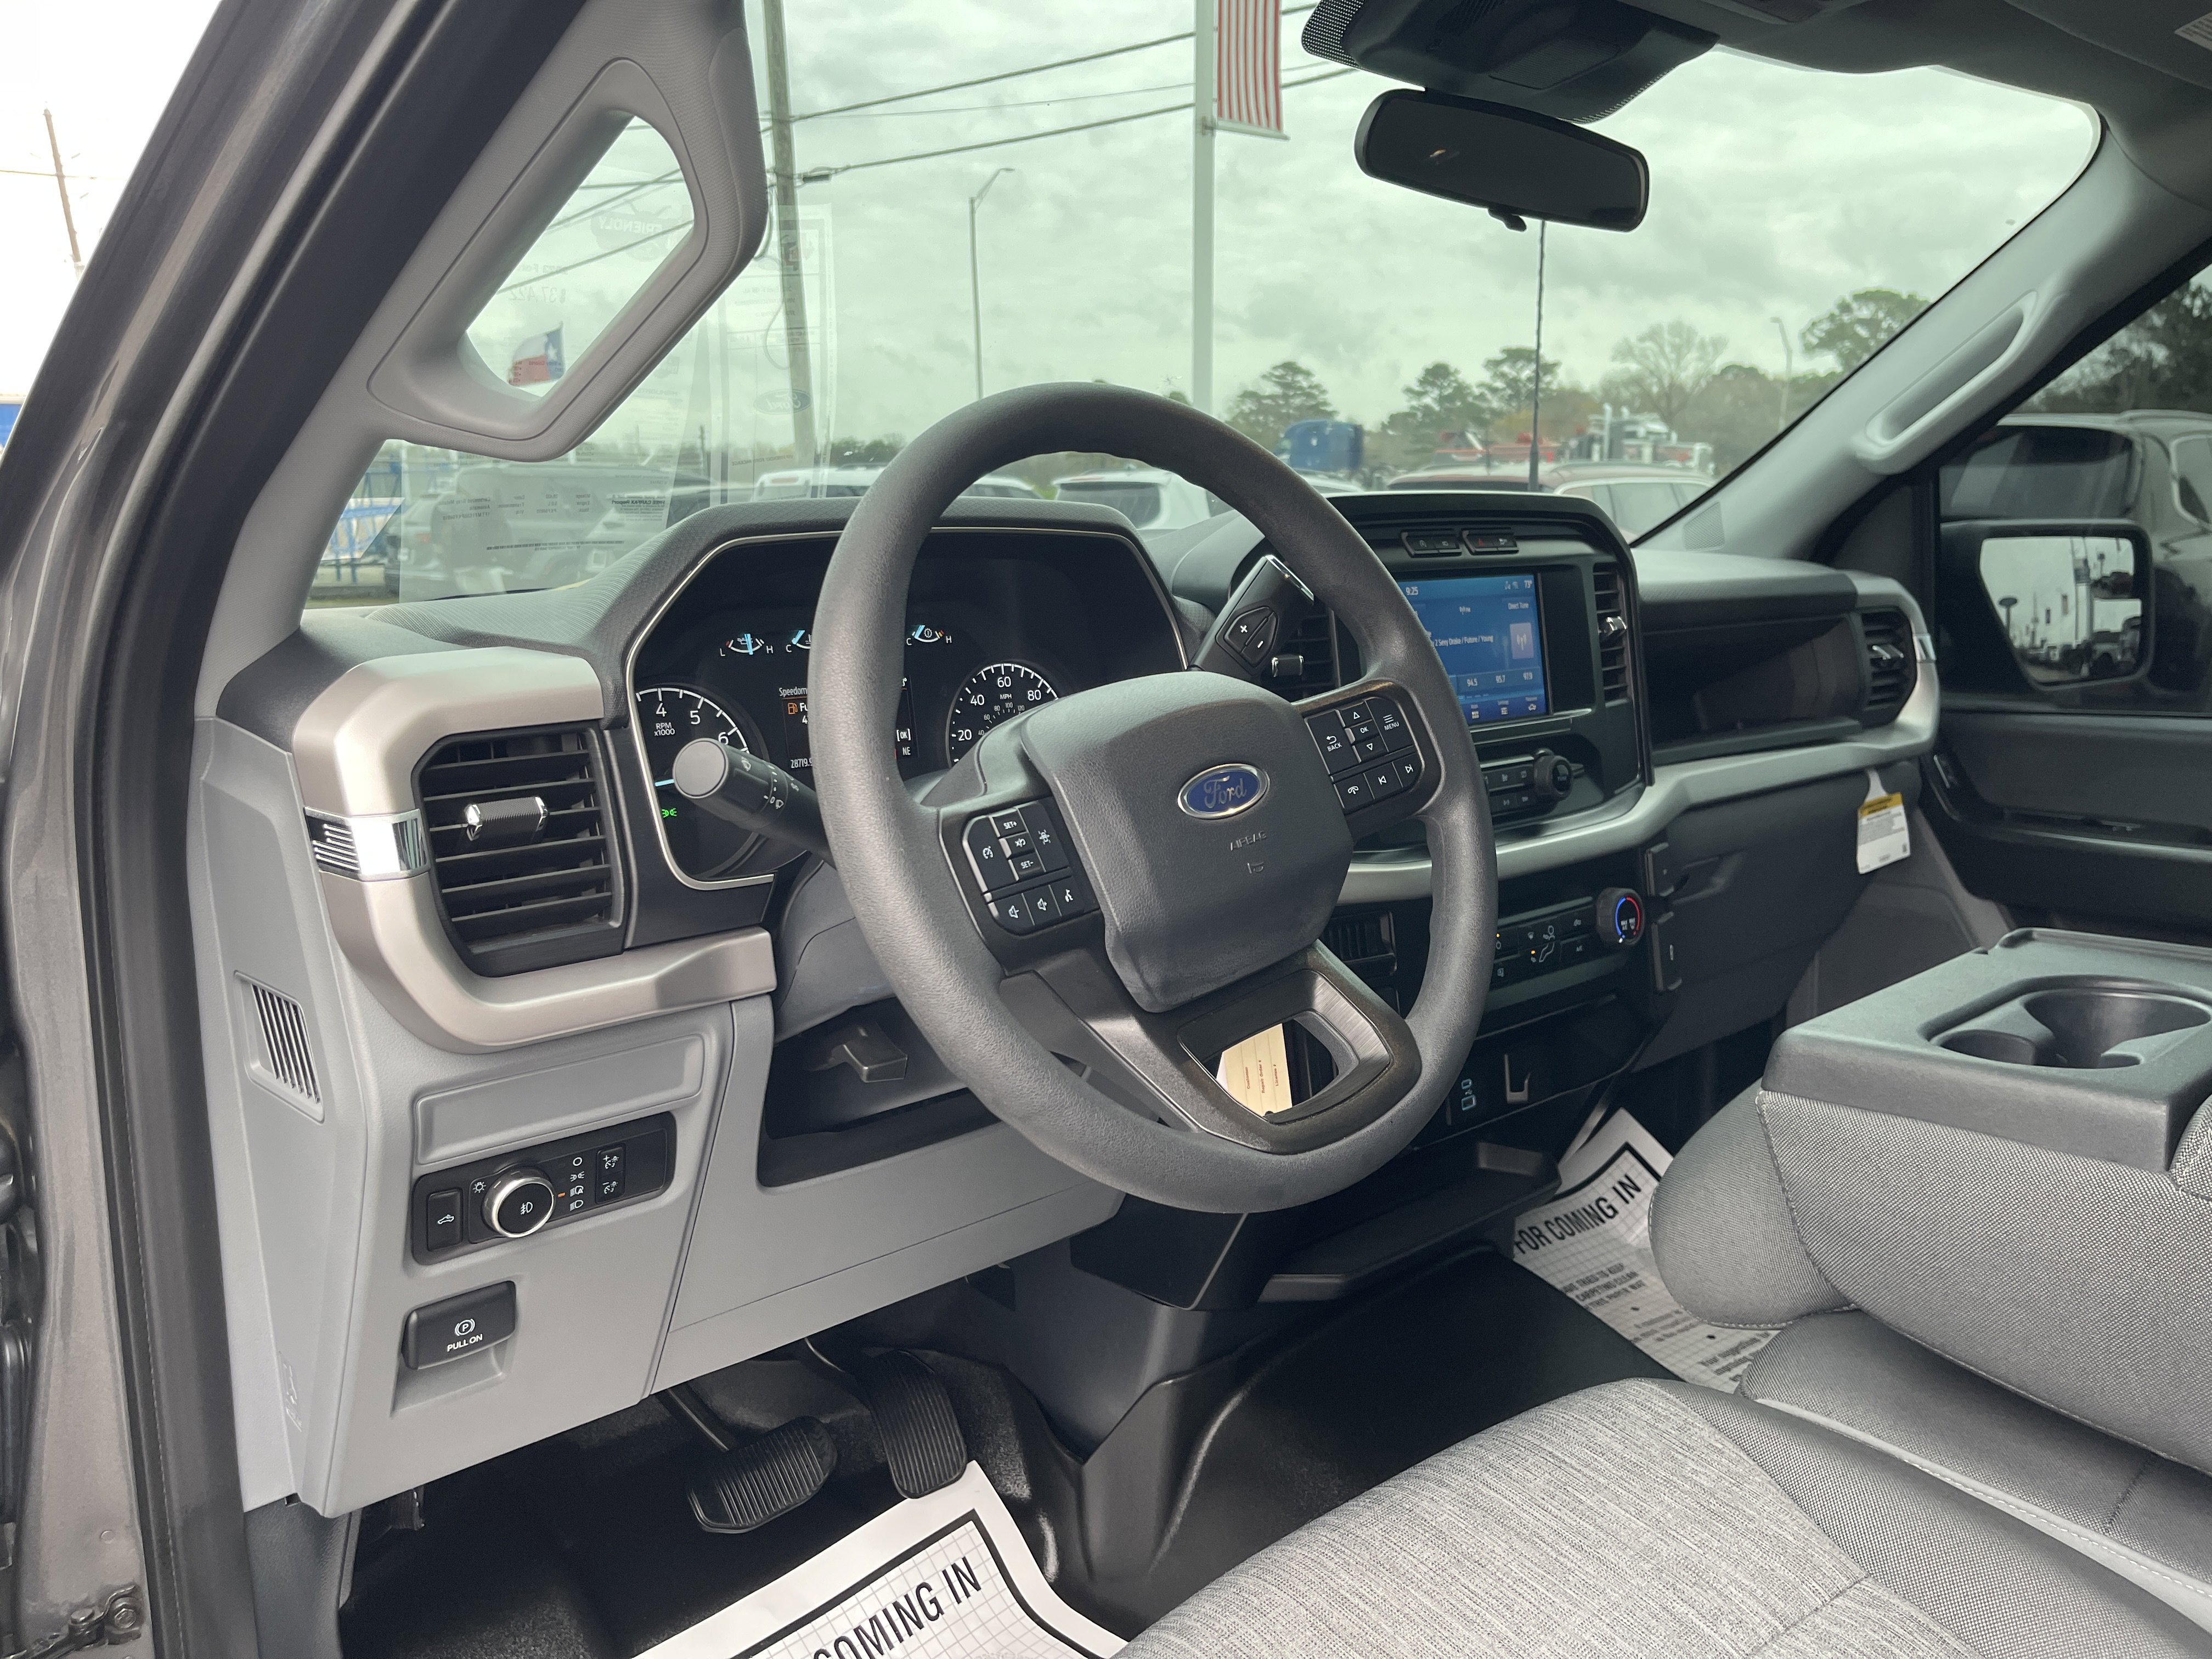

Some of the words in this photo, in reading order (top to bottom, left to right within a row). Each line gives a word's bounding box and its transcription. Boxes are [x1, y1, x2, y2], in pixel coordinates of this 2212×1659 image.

[1406, 586, 1419, 596] 9:25
[906, 637, 912, 646] C
[945, 635, 952, 644] H
[719, 648, 726, 657] L
[766, 645, 774, 654] H
[786, 644, 792, 653] C
[997, 676, 1012, 687] 60
[970, 694, 985, 706] 40
[1027, 689, 1042, 701] 80
[656, 702, 668, 718] 4
[690, 710, 701, 725] 5
[653, 727, 675, 736] x1000
[1384, 721, 1400, 731] MENU
[718, 731, 729, 746] 6
[957, 729, 972, 741] 20
[902, 747, 911, 755] NE
[1327, 742, 1342, 752] BACK
[1203, 775, 1247, 809] Ford
[1544, 1197, 1619, 1240] COMING
[1611, 1173, 1642, 1205] IN
[447, 1339, 469, 1352] PULL
[469, 1334, 483, 1344] ON
[814, 1582, 945, 1659] OMING
[942, 1556, 981, 1605] IN
